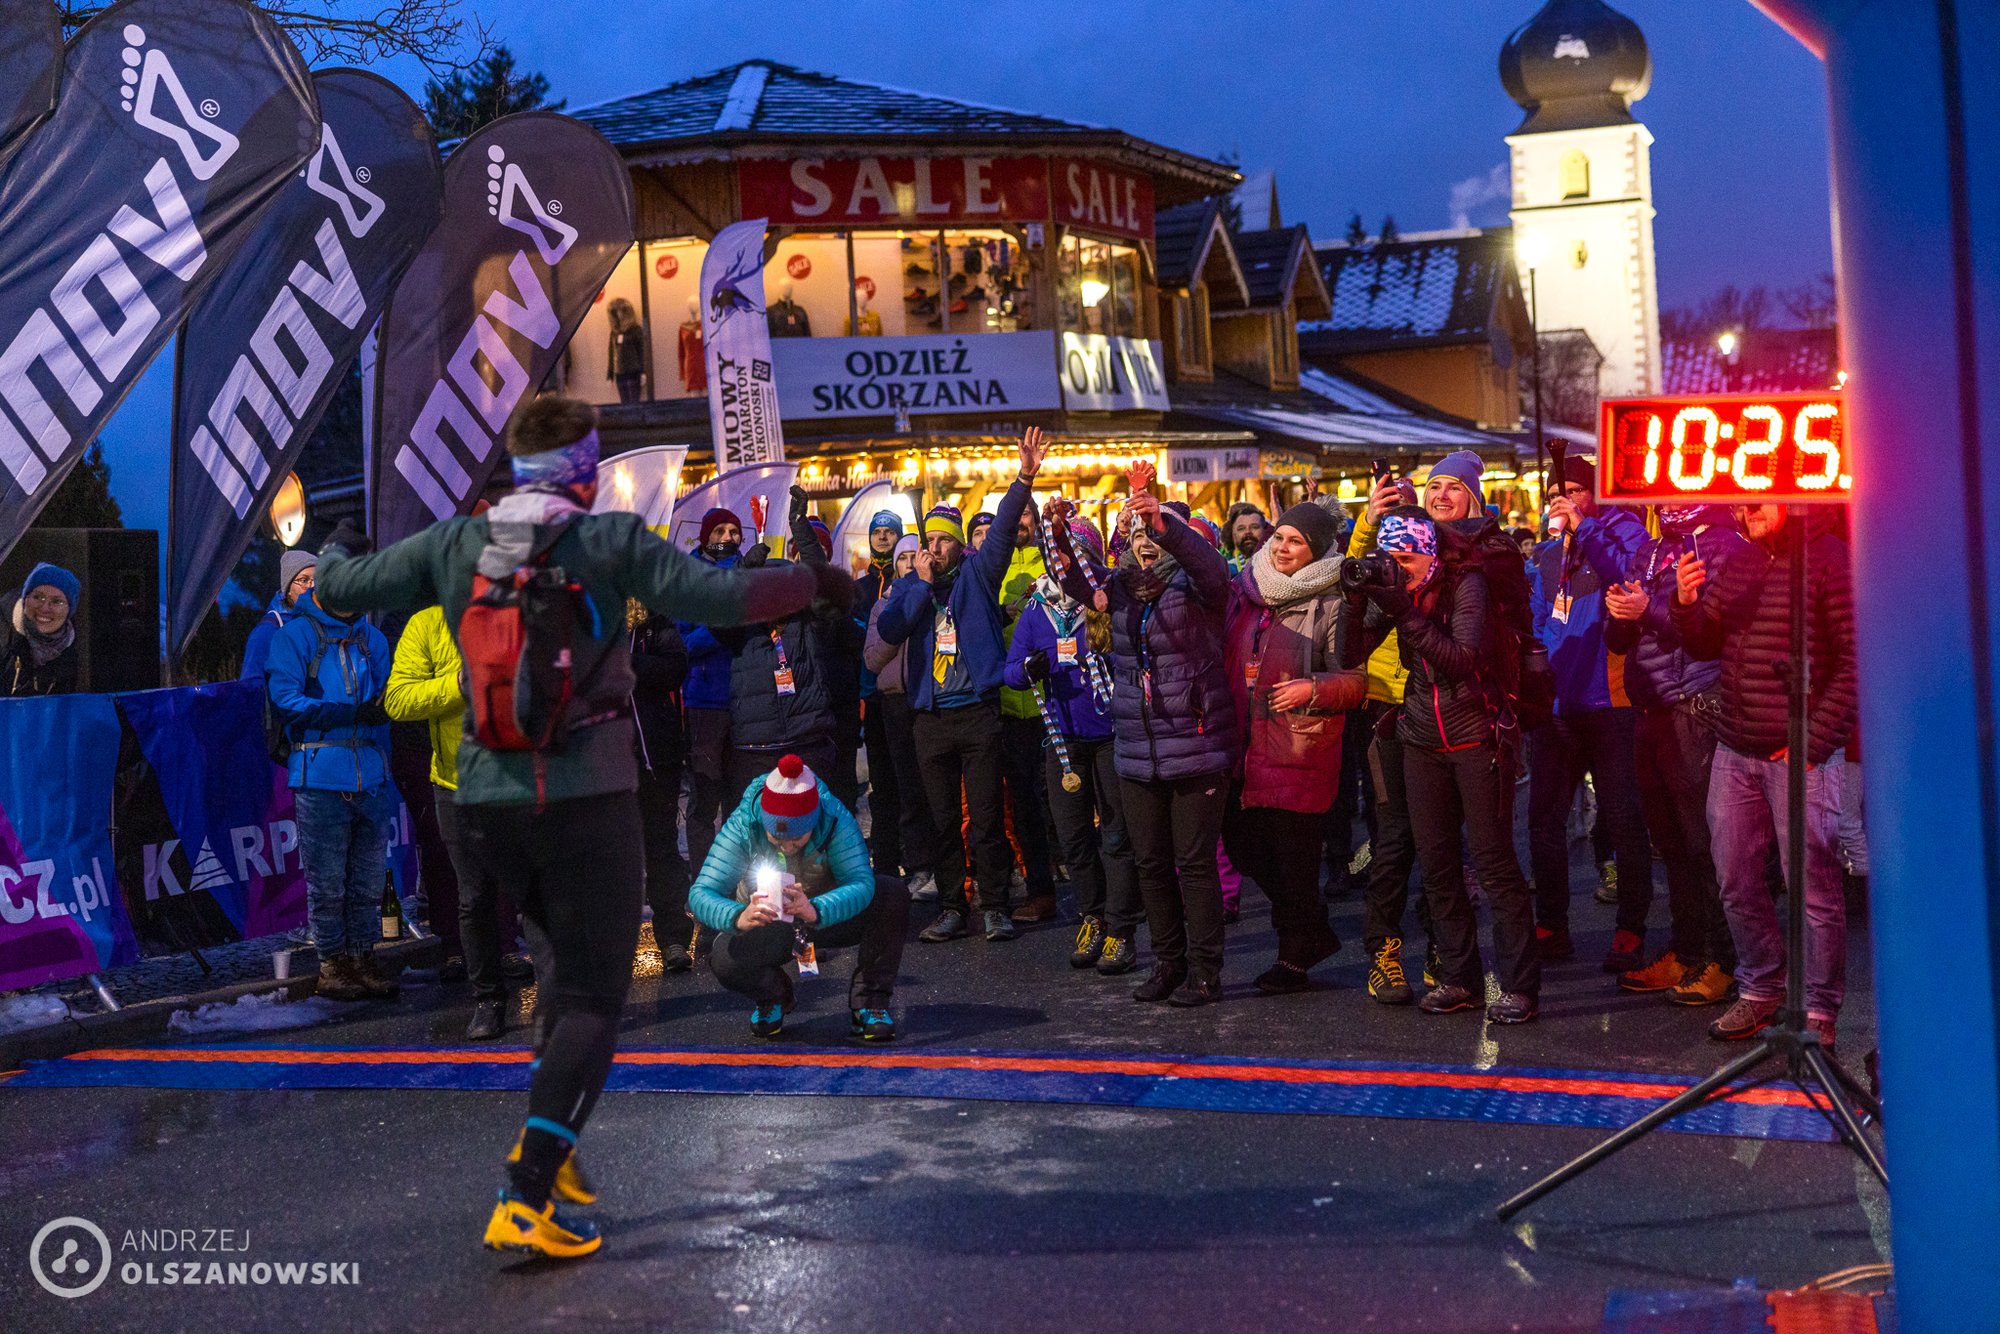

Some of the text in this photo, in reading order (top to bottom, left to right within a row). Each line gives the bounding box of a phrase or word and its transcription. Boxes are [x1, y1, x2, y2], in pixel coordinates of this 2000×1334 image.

[790, 157, 1001, 217] SALE
[1066, 161, 1141, 231] SALE
[845, 339, 972, 378] ODZIEŻ
[736, 366, 756, 466] RAMARATON
[812, 375, 1010, 412] SKÓRZANA
